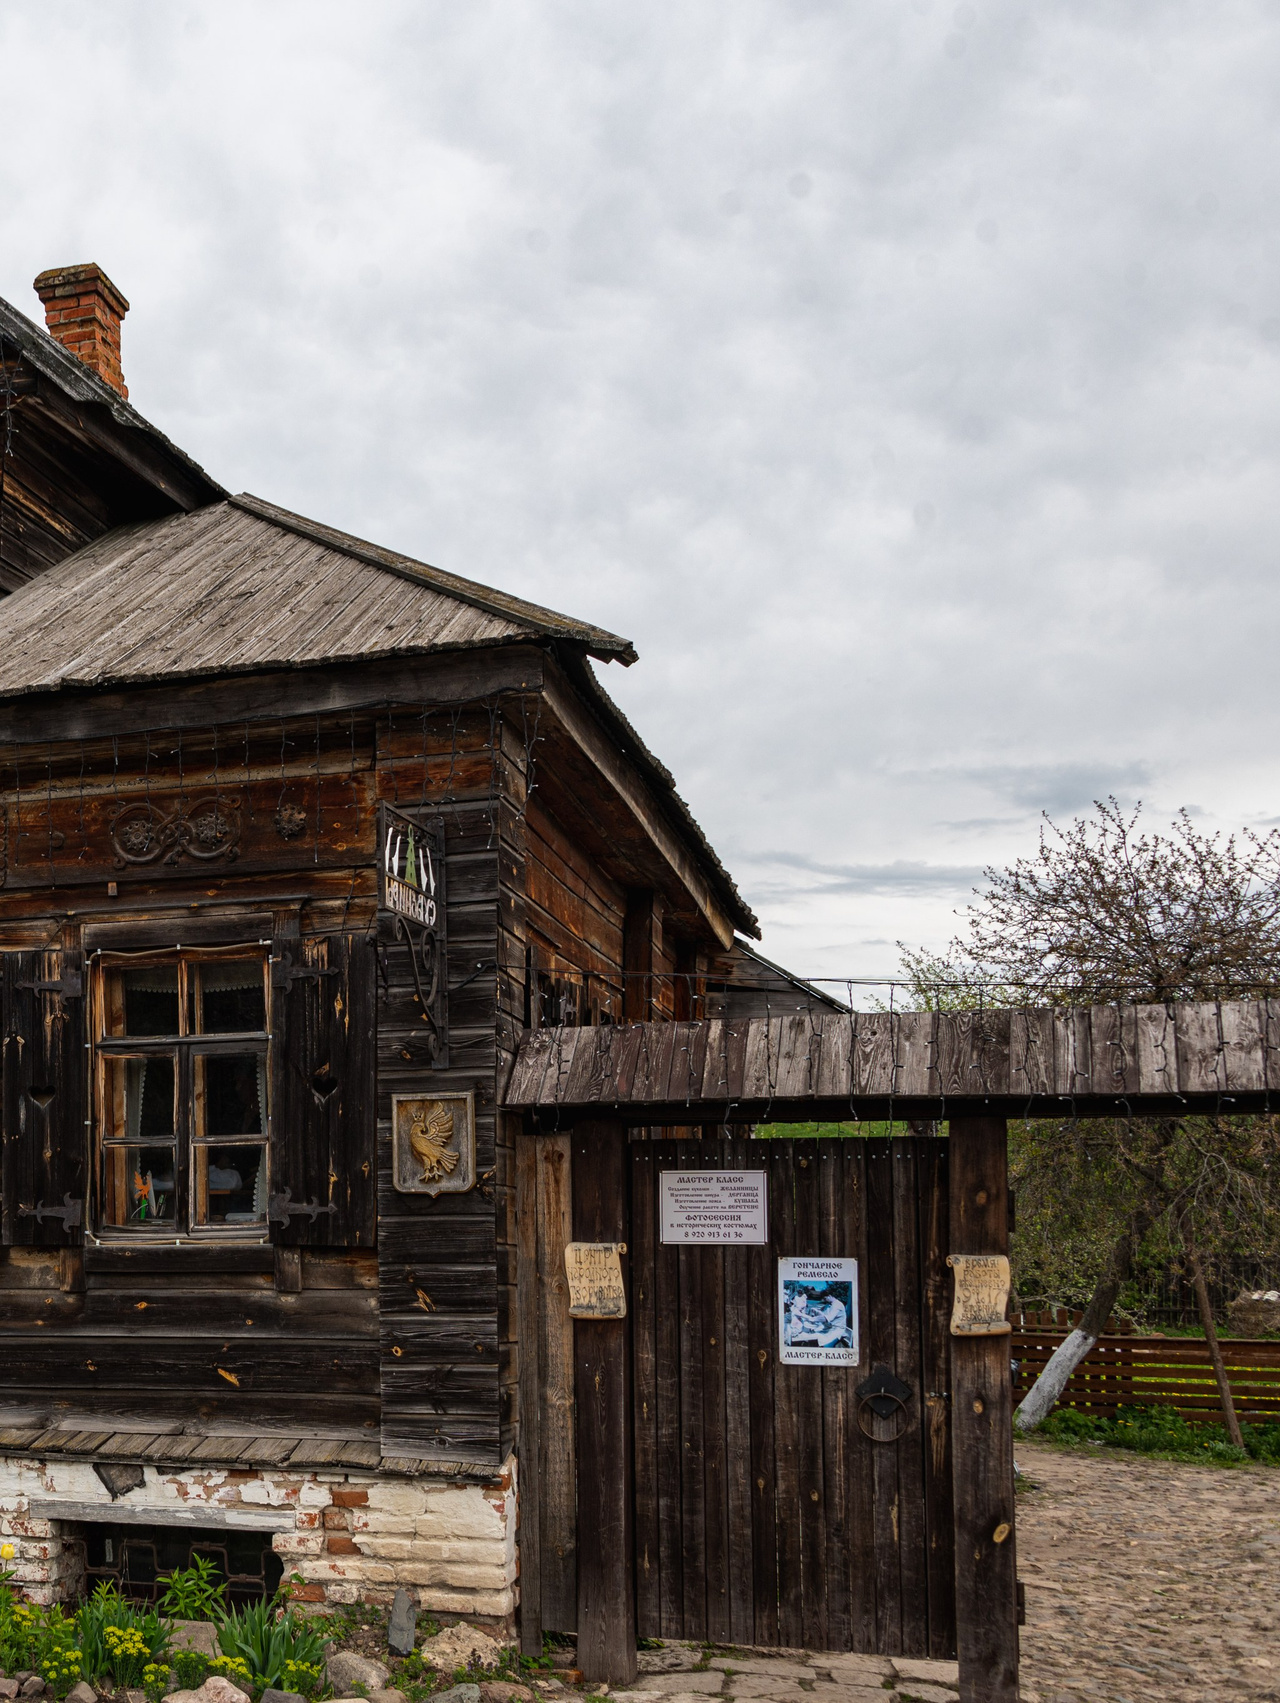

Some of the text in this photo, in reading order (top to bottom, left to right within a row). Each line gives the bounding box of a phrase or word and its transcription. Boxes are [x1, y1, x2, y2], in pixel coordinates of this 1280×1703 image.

[792, 1262, 843, 1270] ГОНЧАРНОЕ
[797, 1270, 839, 1278] РЕМЕСЛО
[784, 1351, 853, 1360] МАСТЕР-КЛАСС
